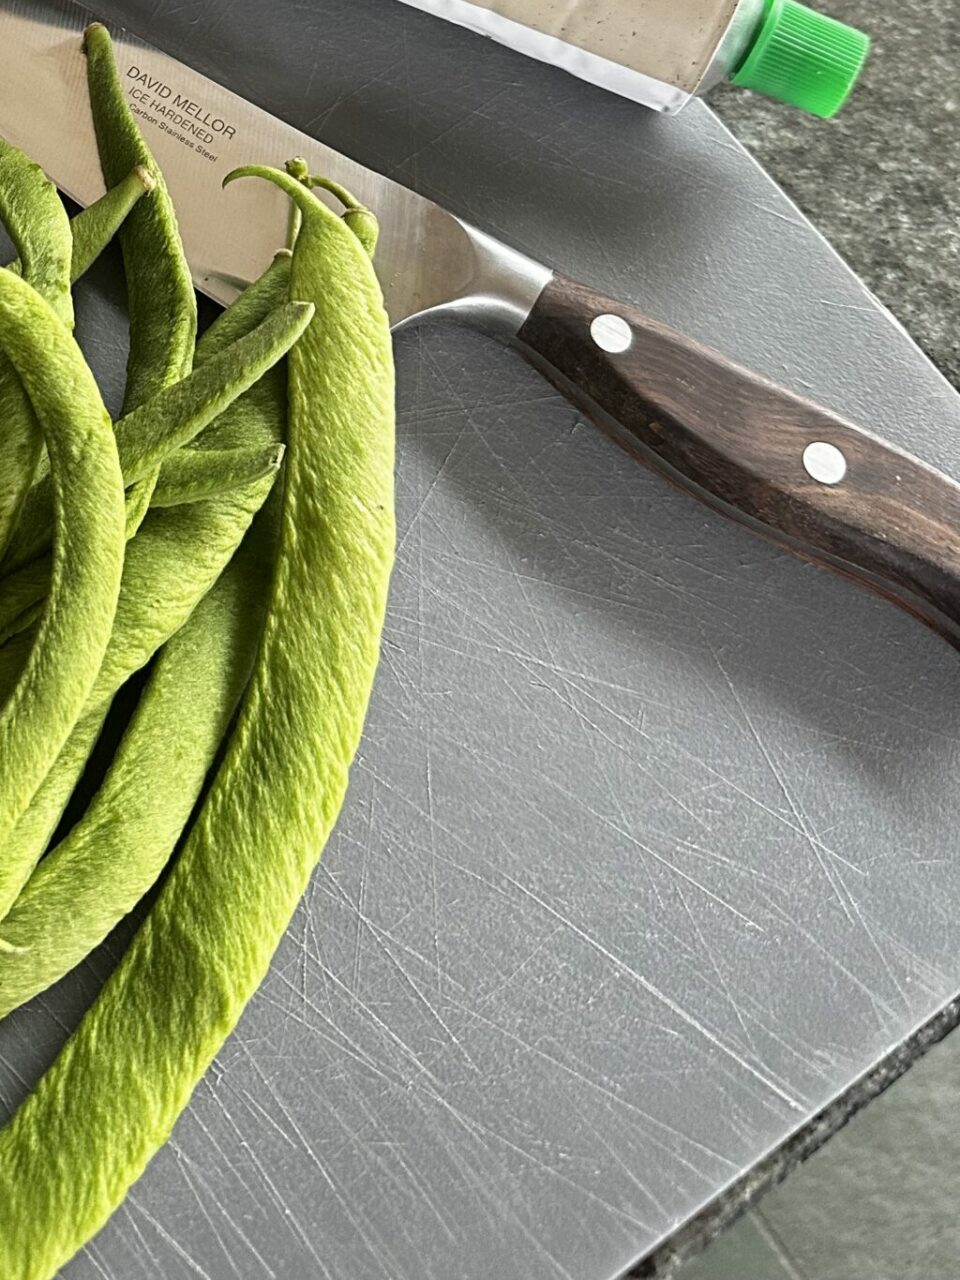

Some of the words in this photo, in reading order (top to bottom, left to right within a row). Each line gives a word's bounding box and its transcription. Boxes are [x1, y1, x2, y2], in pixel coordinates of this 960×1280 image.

[126, 65, 172, 99] DAVID
[172, 94, 237, 140] MELLOR
[128, 86, 151, 105] ICE
[149, 99, 214, 144] HARDENED
[129, 102, 158, 126] Carbon
[158, 122, 195, 149] Stainless
[195, 144, 219, 163] Steel
